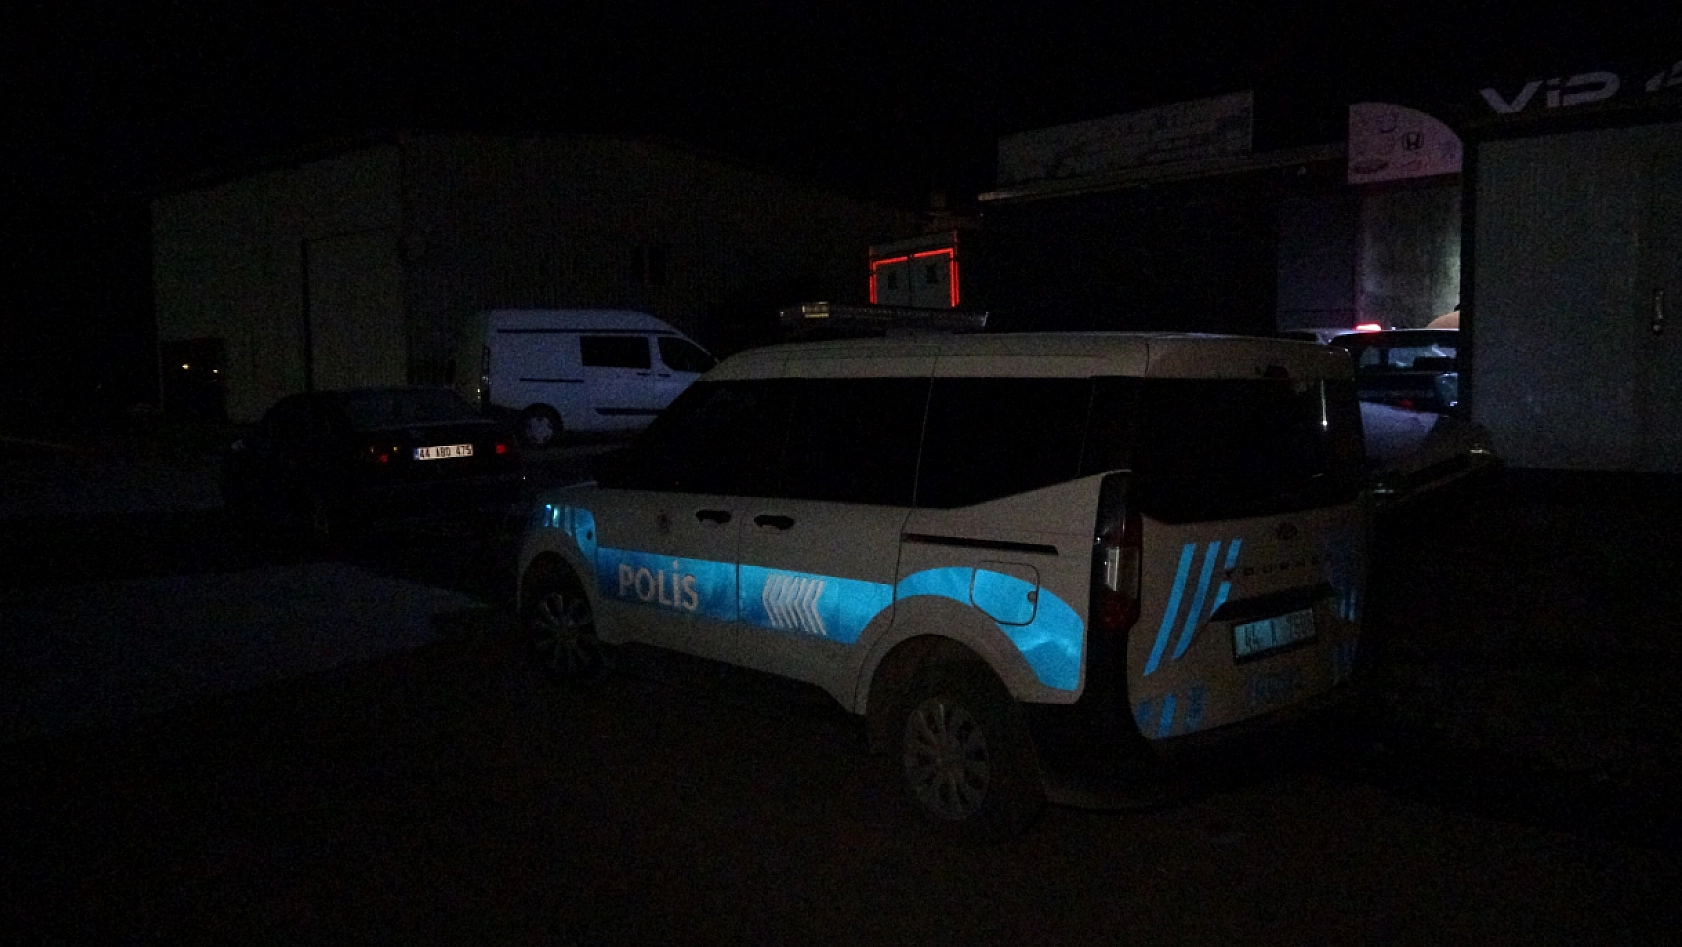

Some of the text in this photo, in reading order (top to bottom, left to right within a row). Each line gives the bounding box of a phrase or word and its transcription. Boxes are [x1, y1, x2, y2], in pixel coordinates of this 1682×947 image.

[420, 448, 431, 458] 44
[456, 445, 472, 455] 475
[618, 559, 699, 612] POLİS
